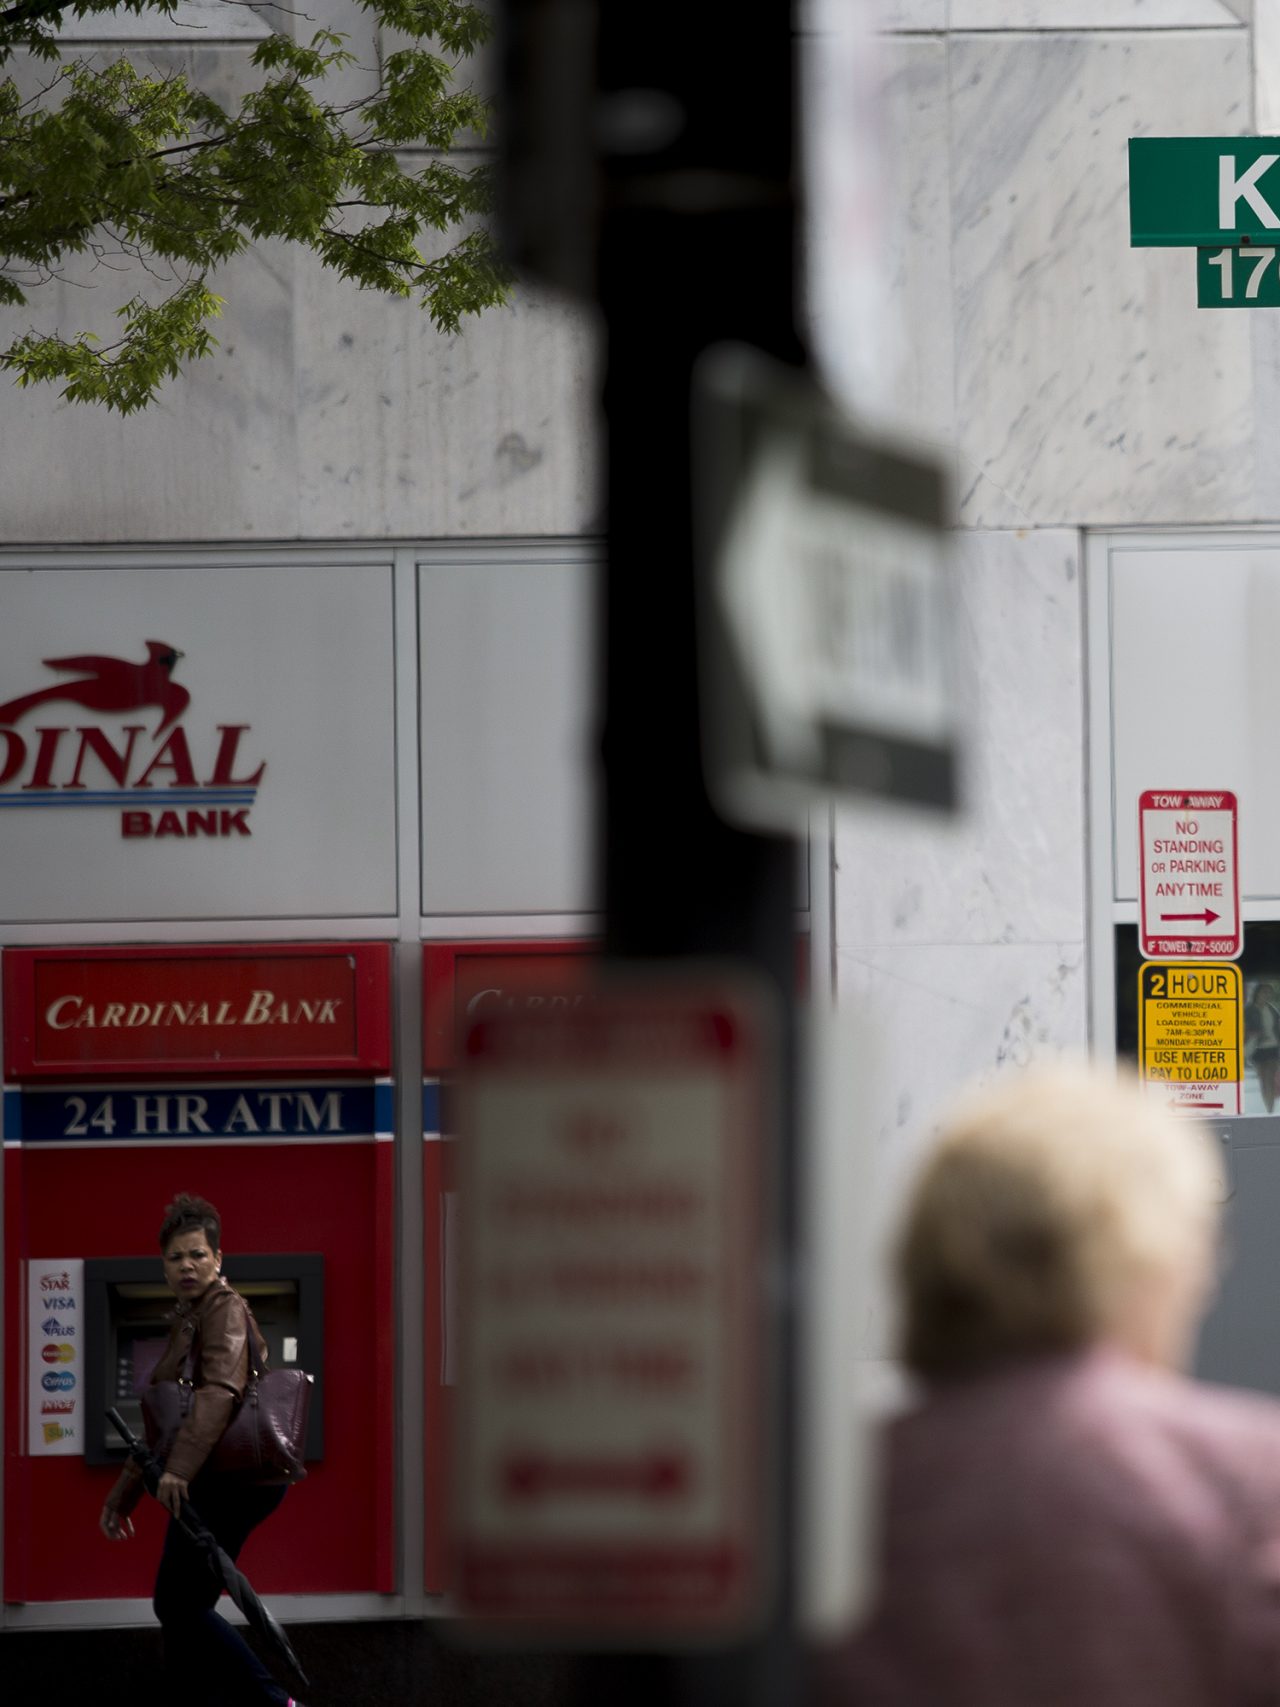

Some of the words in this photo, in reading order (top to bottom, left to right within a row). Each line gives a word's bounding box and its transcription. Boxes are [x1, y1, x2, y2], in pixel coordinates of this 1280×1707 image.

[1152, 796, 1182, 809] TOW
[1187, 796, 1224, 809] AWAY
[121, 809, 253, 839] BANK
[1176, 821, 1199, 835] NO
[1153, 840, 1224, 854] STANDING
[1152, 862, 1166, 873] OR
[1170, 859, 1226, 873] PARKING
[1155, 883, 1224, 897] ANYTIME
[1158, 941, 1188, 953] TOWED
[1150, 974, 1166, 996] 2
[1172, 975, 1228, 994] HOUR
[45, 994, 237, 1030] CARDINAL
[243, 989, 344, 1026] BANK
[1154, 1052, 1178, 1064] USE
[1182, 1051, 1226, 1063] METER
[1150, 1068, 1173, 1081] PAY
[1177, 1067, 1193, 1081] TO
[1196, 1067, 1228, 1080] LOAD
[63, 1095, 117, 1136] 24
[131, 1093, 216, 1134] HR
[224, 1090, 346, 1133] ATM
[40, 1277, 71, 1291] STAR
[43, 1297, 76, 1310] VISA
[50, 1325, 76, 1337] PLUS
